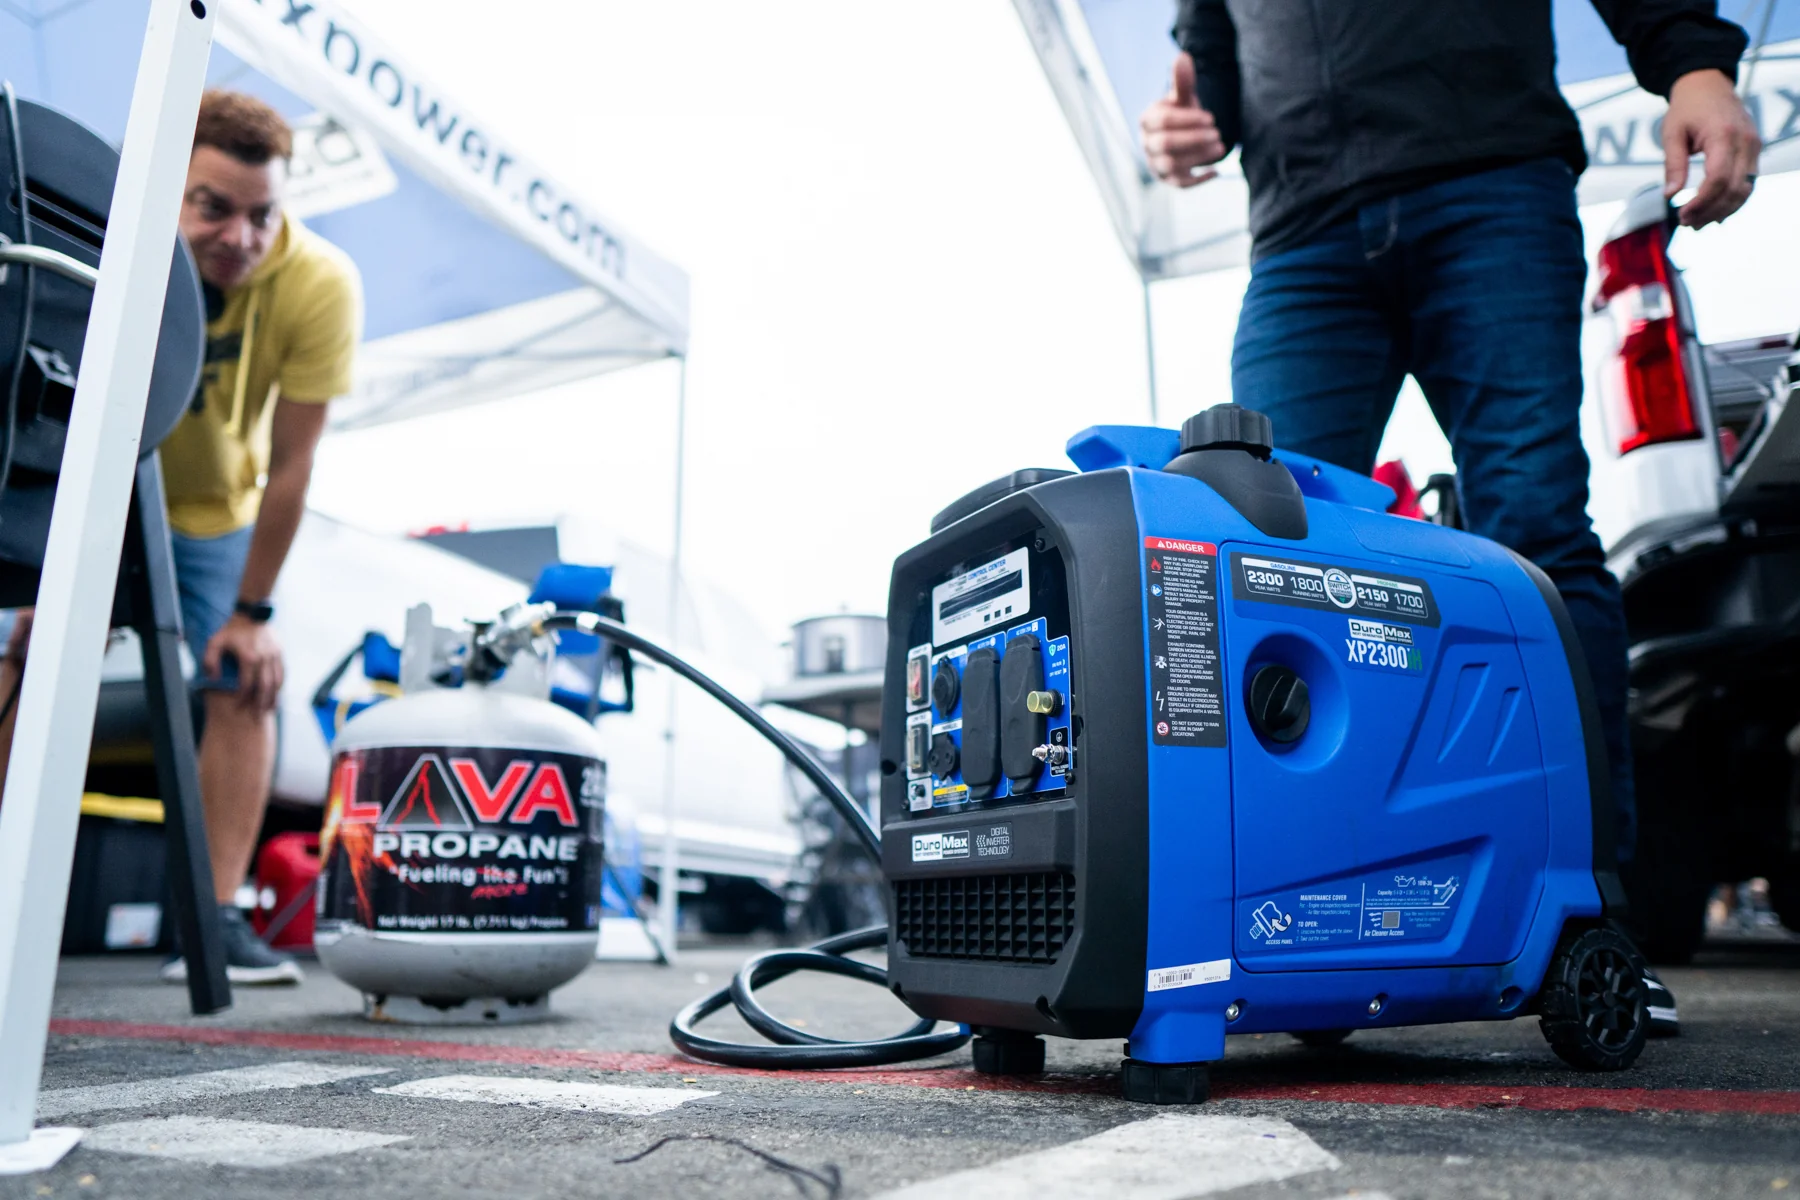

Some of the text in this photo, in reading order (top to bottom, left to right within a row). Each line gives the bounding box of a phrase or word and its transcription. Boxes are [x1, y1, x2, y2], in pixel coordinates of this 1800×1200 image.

[1166, 541, 1204, 552] DANGER
[1270, 563, 1296, 572] GASOLINE
[1247, 570, 1324, 592] 2300 1800
[1329, 582, 1350, 590] SWITCH
[1356, 587, 1389, 602] 2150
[1394, 593, 1423, 608] 1700
[1056, 644, 1066, 652] 20A
[340, 753, 579, 832] LAVA
[991, 827, 1009, 836] DIGITAL
[986, 836, 1010, 846] INVERTER
[372, 833, 579, 861] PROPANE
[978, 846, 1010, 857] TECHNOLOGY
